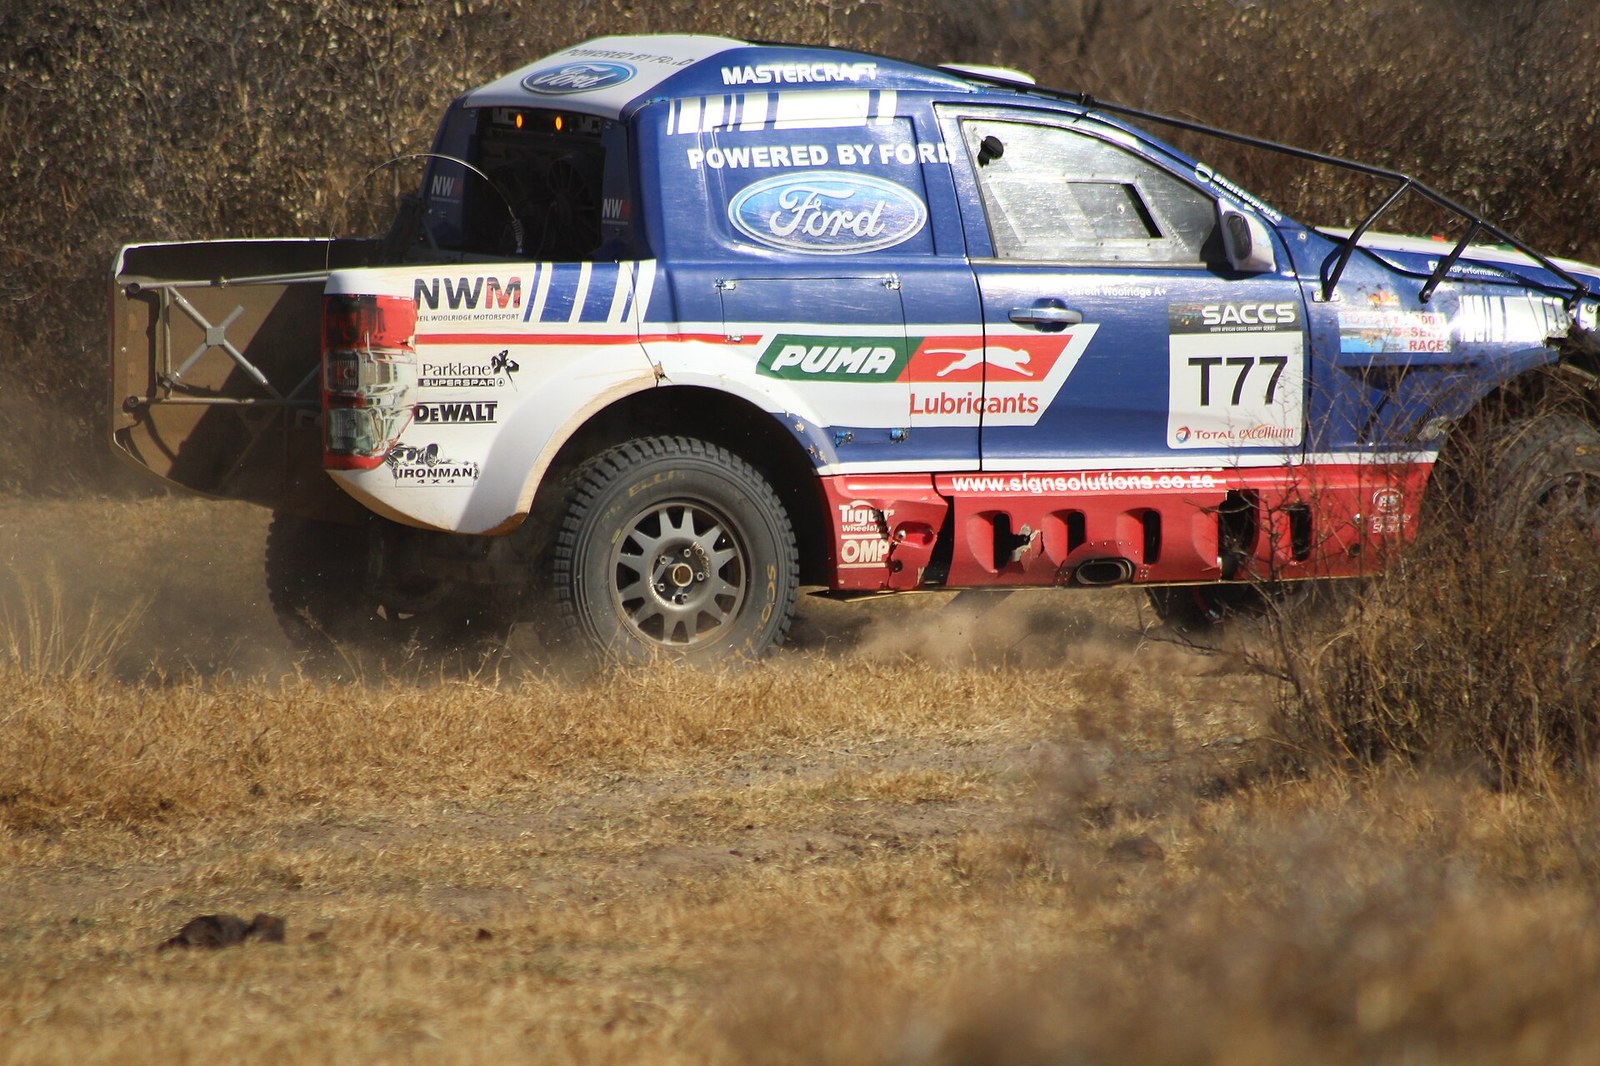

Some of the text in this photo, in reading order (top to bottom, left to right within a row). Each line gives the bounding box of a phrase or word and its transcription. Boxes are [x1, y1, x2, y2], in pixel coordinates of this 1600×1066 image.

[629, 52, 652, 62] BY
[533, 65, 617, 88] Ford
[721, 62, 877, 85] MASTERCRAFT
[687, 142, 957, 170] POWERED BY FORD
[431, 174, 463, 199] NW
[602, 198, 631, 219] NW
[769, 185, 887, 238] Ford
[413, 276, 522, 310] NWM
[473, 313, 519, 321] MOTORSPORT
[1202, 303, 1296, 325] SACCS
[1408, 340, 1444, 351] RACE
[422, 362, 491, 376] Parklane
[770, 344, 897, 374] PUMA
[423, 379, 495, 387] SUPERSPAR
[1188, 355, 1289, 407] T77
[910, 391, 1040, 416] Lubricants
[1194, 425, 1294, 440] TOTAL excellium
[399, 467, 473, 479] IRONMAN
[951, 472, 1216, 494] www.signsolutions.co.za
[841, 539, 890, 563] OMP
